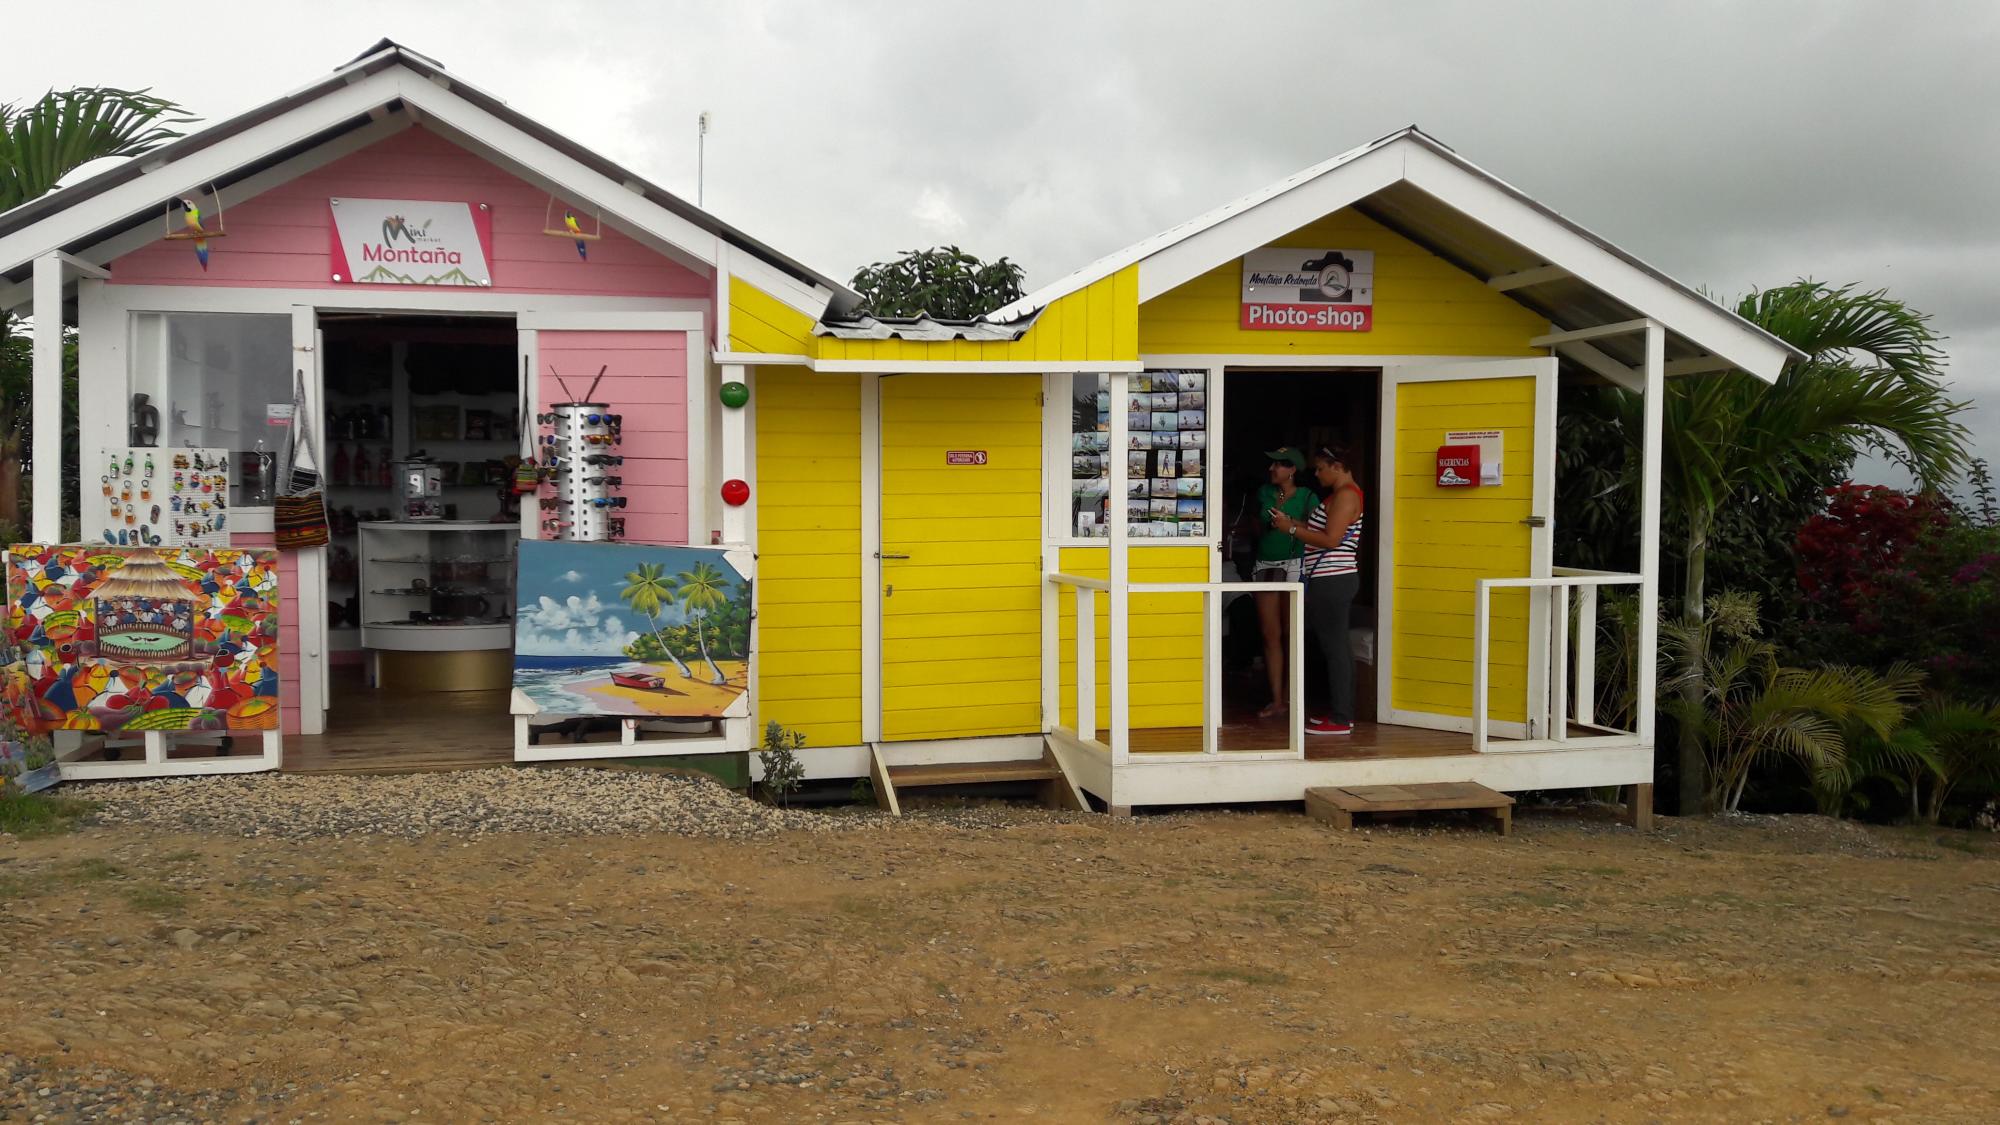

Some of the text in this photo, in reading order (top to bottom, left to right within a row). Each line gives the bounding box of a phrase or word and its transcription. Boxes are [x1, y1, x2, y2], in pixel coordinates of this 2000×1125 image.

[382, 215, 433, 248] Mini
[362, 243, 462, 265] Montaña
[1249, 272, 1318, 286] Montaña Redonda
[1249, 304, 1365, 330] Photo-shop
